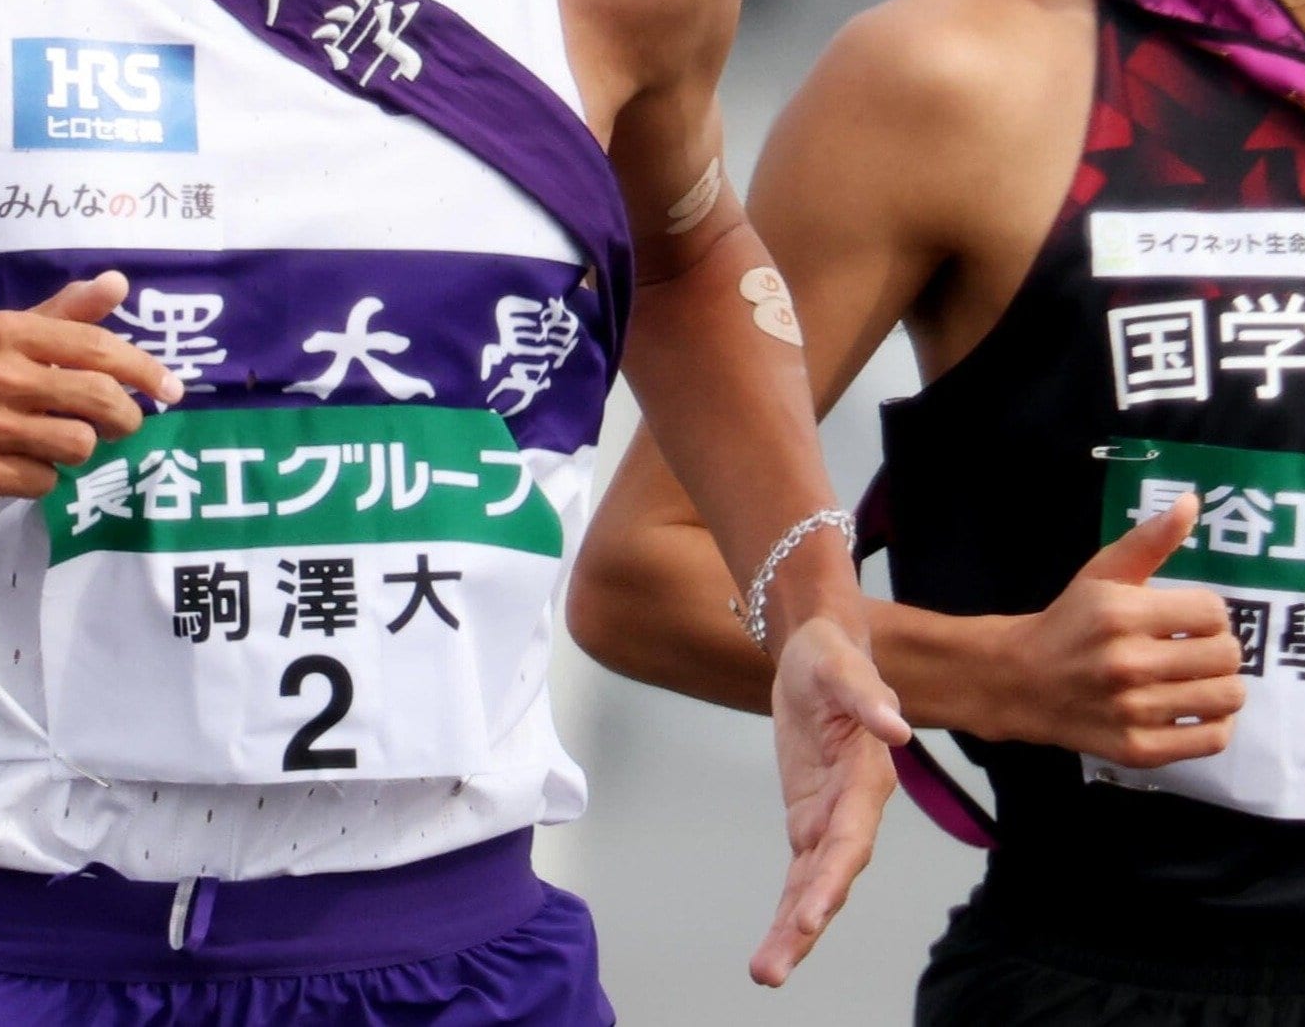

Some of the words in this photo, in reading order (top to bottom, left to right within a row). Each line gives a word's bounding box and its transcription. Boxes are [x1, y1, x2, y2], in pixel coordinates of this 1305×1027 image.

[46, 47, 161, 112] HRS
[172, 554, 463, 644] 駒澤大
[279, 654, 358, 772] 2
